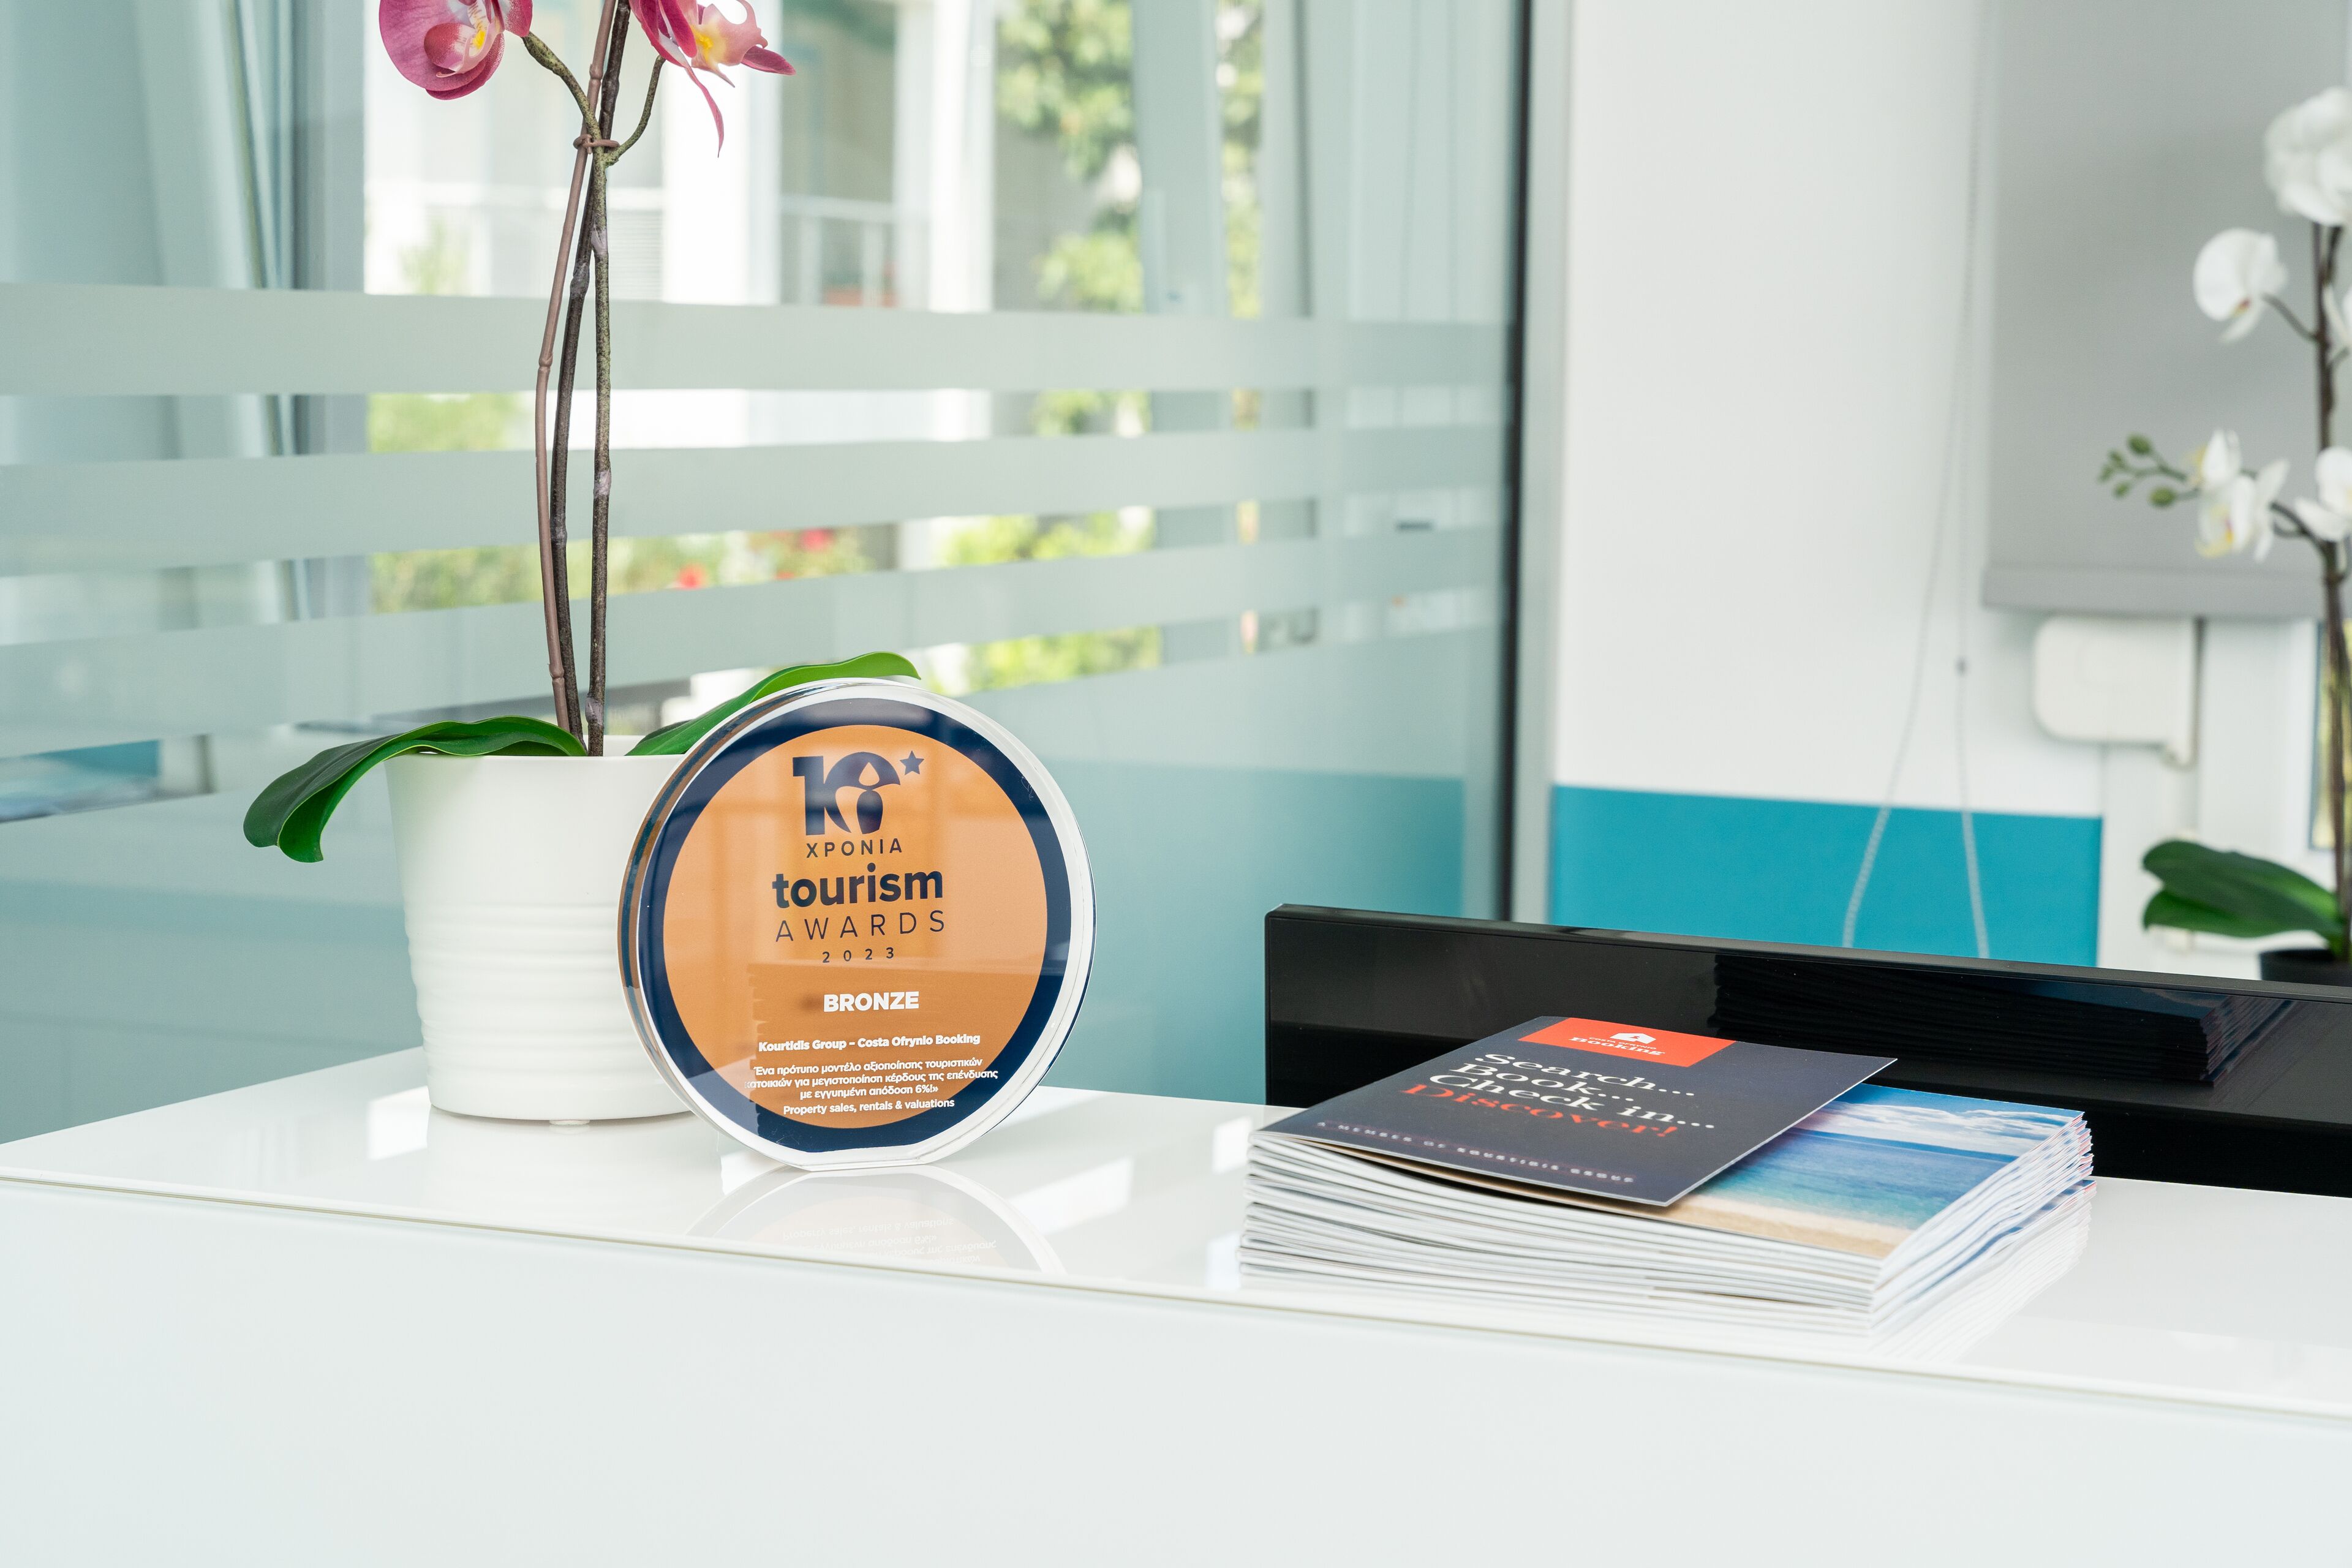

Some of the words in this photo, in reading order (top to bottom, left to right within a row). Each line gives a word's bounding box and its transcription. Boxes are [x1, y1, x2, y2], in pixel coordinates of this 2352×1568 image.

[806, 838, 902, 858] ΧΡΟΝΙΑ
[772, 862, 943, 908] tourism
[775, 910, 944, 942] AWARDS
[822, 947, 894, 963] 2023
[823, 991, 919, 1012] BRONZE
[758, 1040, 810, 1052] Kourtidis
[812, 1040, 846, 1050] Group
[858, 1038, 889, 1048] Costa
[892, 1035, 933, 1047] Ofrynio
[935, 1034, 981, 1044] Booking
[1569, 1037, 1666, 1055] Booking
[777, 1065, 819, 1076] πρότυπο
[821, 1062, 861, 1074] μοντέλο
[863, 1060, 923, 1072] αξιοποίησης
[925, 1057, 983, 1068] τουριστικών
[1475, 1054, 1695, 1096] Search...
[794, 1077, 810, 1088] για
[812, 1074, 883, 1087] μεγιστοποίηση
[885, 1072, 926, 1084] κέρδους
[929, 1072, 944, 1082] της
[946, 1069, 998, 1080] επένδυσης
[1449, 1063, 1634, 1101] Book...
[800, 1091, 812, 1100] με
[814, 1087, 867, 1099] εγγυημένη
[869, 1085, 913, 1095] απόδοση
[1429, 1074, 1605, 1111] Check
[1616, 1106, 1714, 1128] in...
[783, 1105, 827, 1115] Property
[829, 1102, 857, 1113] sales,
[859, 1101, 893, 1111] rentals
[895, 1100, 903, 1109] &
[905, 1099, 955, 1109] valuations
[1401, 1084, 1678, 1137] Discover!
